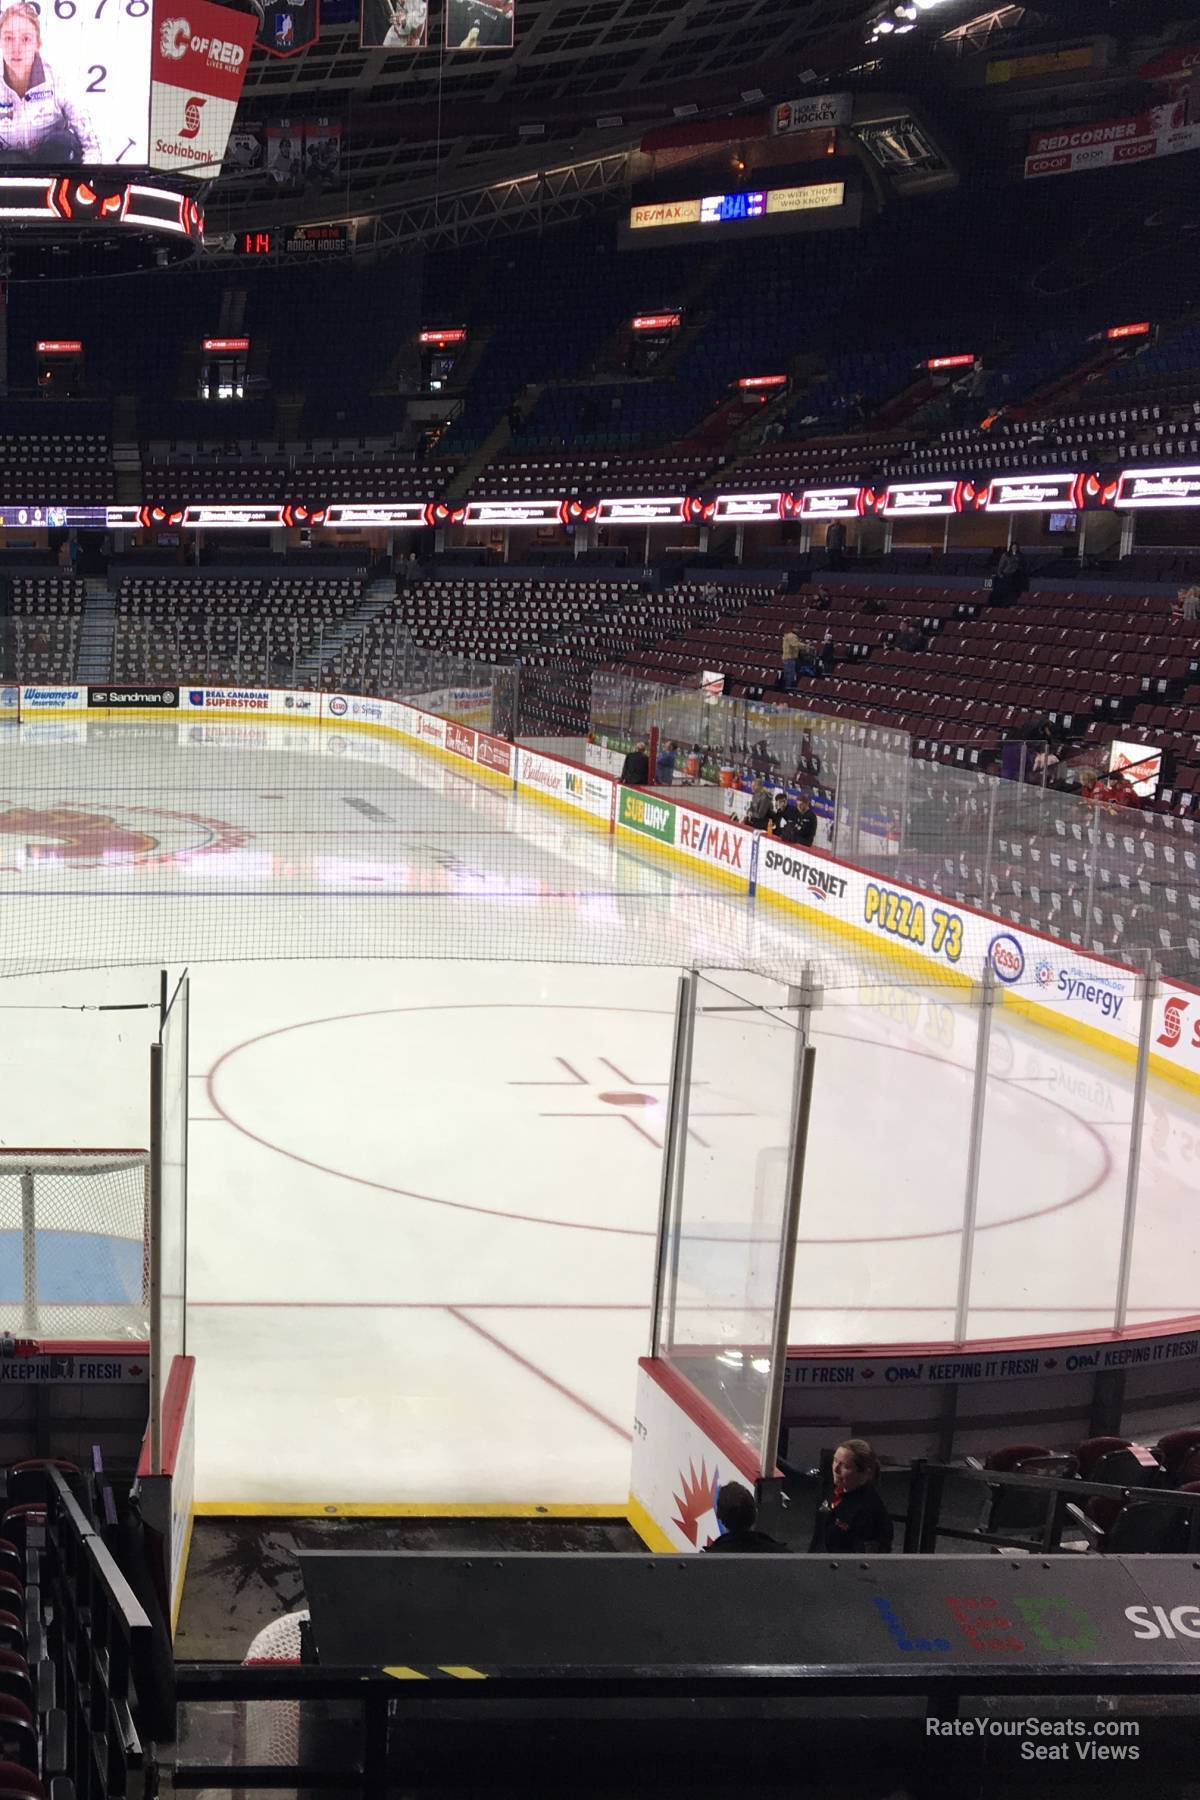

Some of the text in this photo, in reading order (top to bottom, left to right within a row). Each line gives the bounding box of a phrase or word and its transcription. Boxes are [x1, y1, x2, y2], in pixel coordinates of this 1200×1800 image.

[190, 36, 209, 53] OF
[208, 37, 244, 66] RED
[206, 60, 240, 74] LIVES HERE
[86, 65, 107, 93] 2
[794, 111, 837, 125] HOCKEY
[1037, 123, 1137, 152] RED CORNER
[155, 138, 214, 163] Scotiabank
[772, 187, 838, 201] GO WITH THOSE
[780, 196, 829, 207] WHO KNOW
[246, 233, 270, 254] 1:14
[317, 239, 346, 251] HOUSE
[24, 688, 80, 700] Wawanesa
[32, 699, 66, 707] Insurance
[109, 692, 162, 703] Sandman
[205, 691, 269, 700] REAL CANADIAN
[205, 700, 269, 709] SUPERSTORE
[361, 704, 383, 719] Synergy
[522, 752, 561, 791] Budweiser
[623, 795, 670, 833] SUBWAY
[680, 814, 744, 870] RE/MAX
[765, 849, 848, 899] SPORTSNET
[864, 883, 963, 963] PIZZA 73
[1057, 969, 1124, 1020] Synergy
[1065, 1339, 1199, 1372] OPA! KEEPING IT FRESH
[79, 1363, 122, 1380] FRESH
[795, 1367, 854, 1383] IT FRESH
[884, 1358, 1039, 1383] OPA! KEEPING IT FRESH
[873, 1597, 1100, 1652] LED
